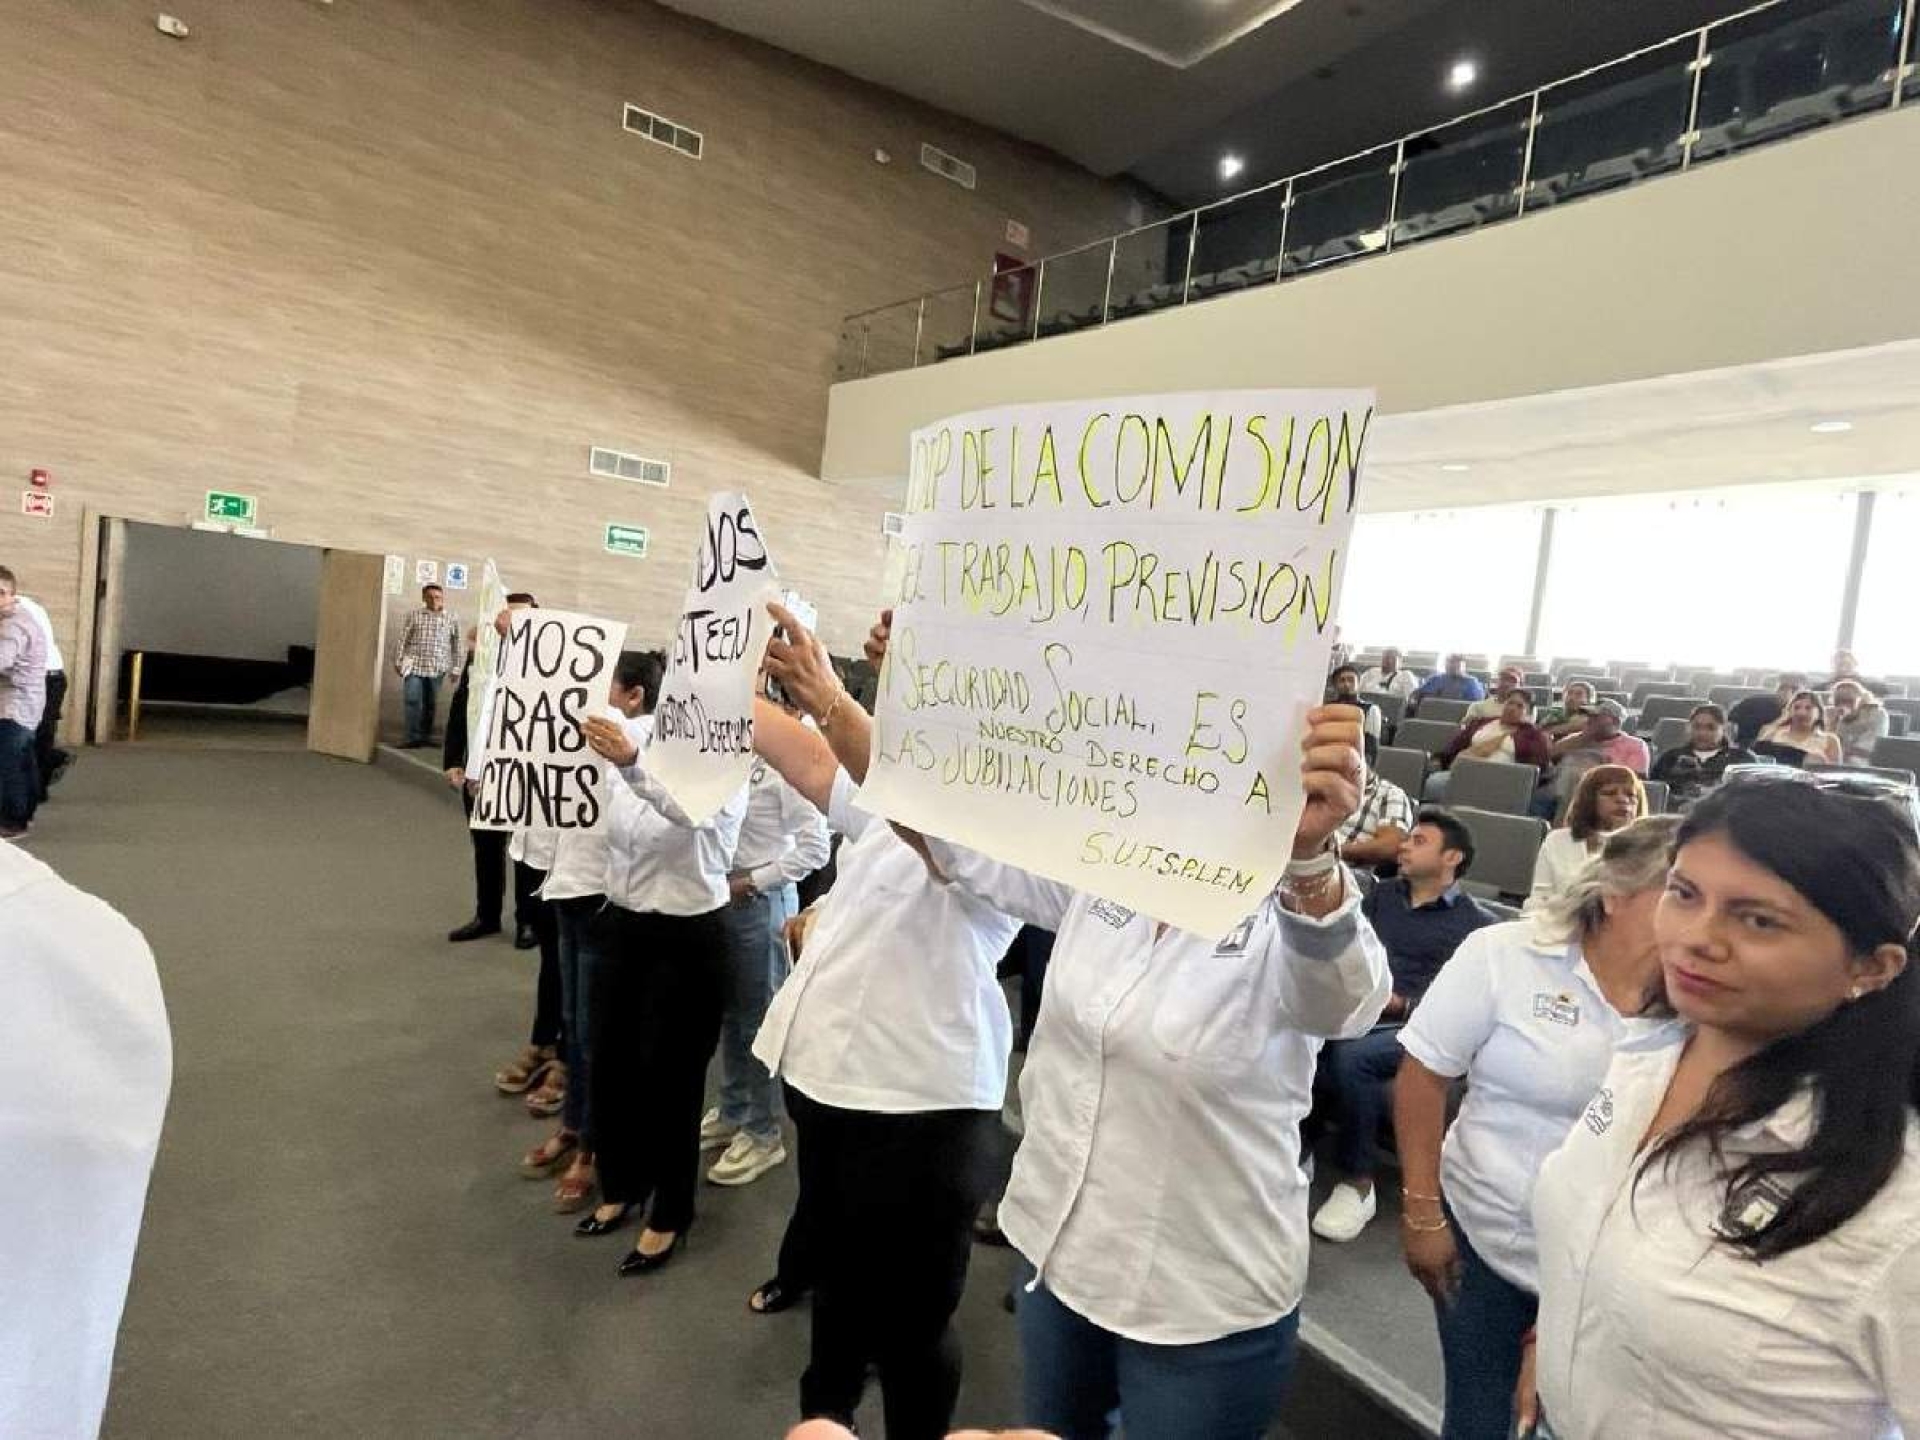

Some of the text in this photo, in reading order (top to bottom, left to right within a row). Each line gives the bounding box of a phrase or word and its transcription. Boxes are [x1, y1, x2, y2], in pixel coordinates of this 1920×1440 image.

[961, 428, 997, 511] DE
[1010, 424, 1064, 509] LA
[1078, 406, 1374, 525] COMISION
[935, 541, 1090, 623] TRABAJO,
[496, 617, 607, 684] MOS
[900, 626, 1031, 715] SEGURIDAD
[1044, 642, 1156, 737] SOCIAL,
[1185, 691, 1250, 765] ES
[878, 728, 936, 771] LAS
[978, 719, 1272, 814] NUESTRO DERECHO A
[474, 757, 600, 829] CIONES
